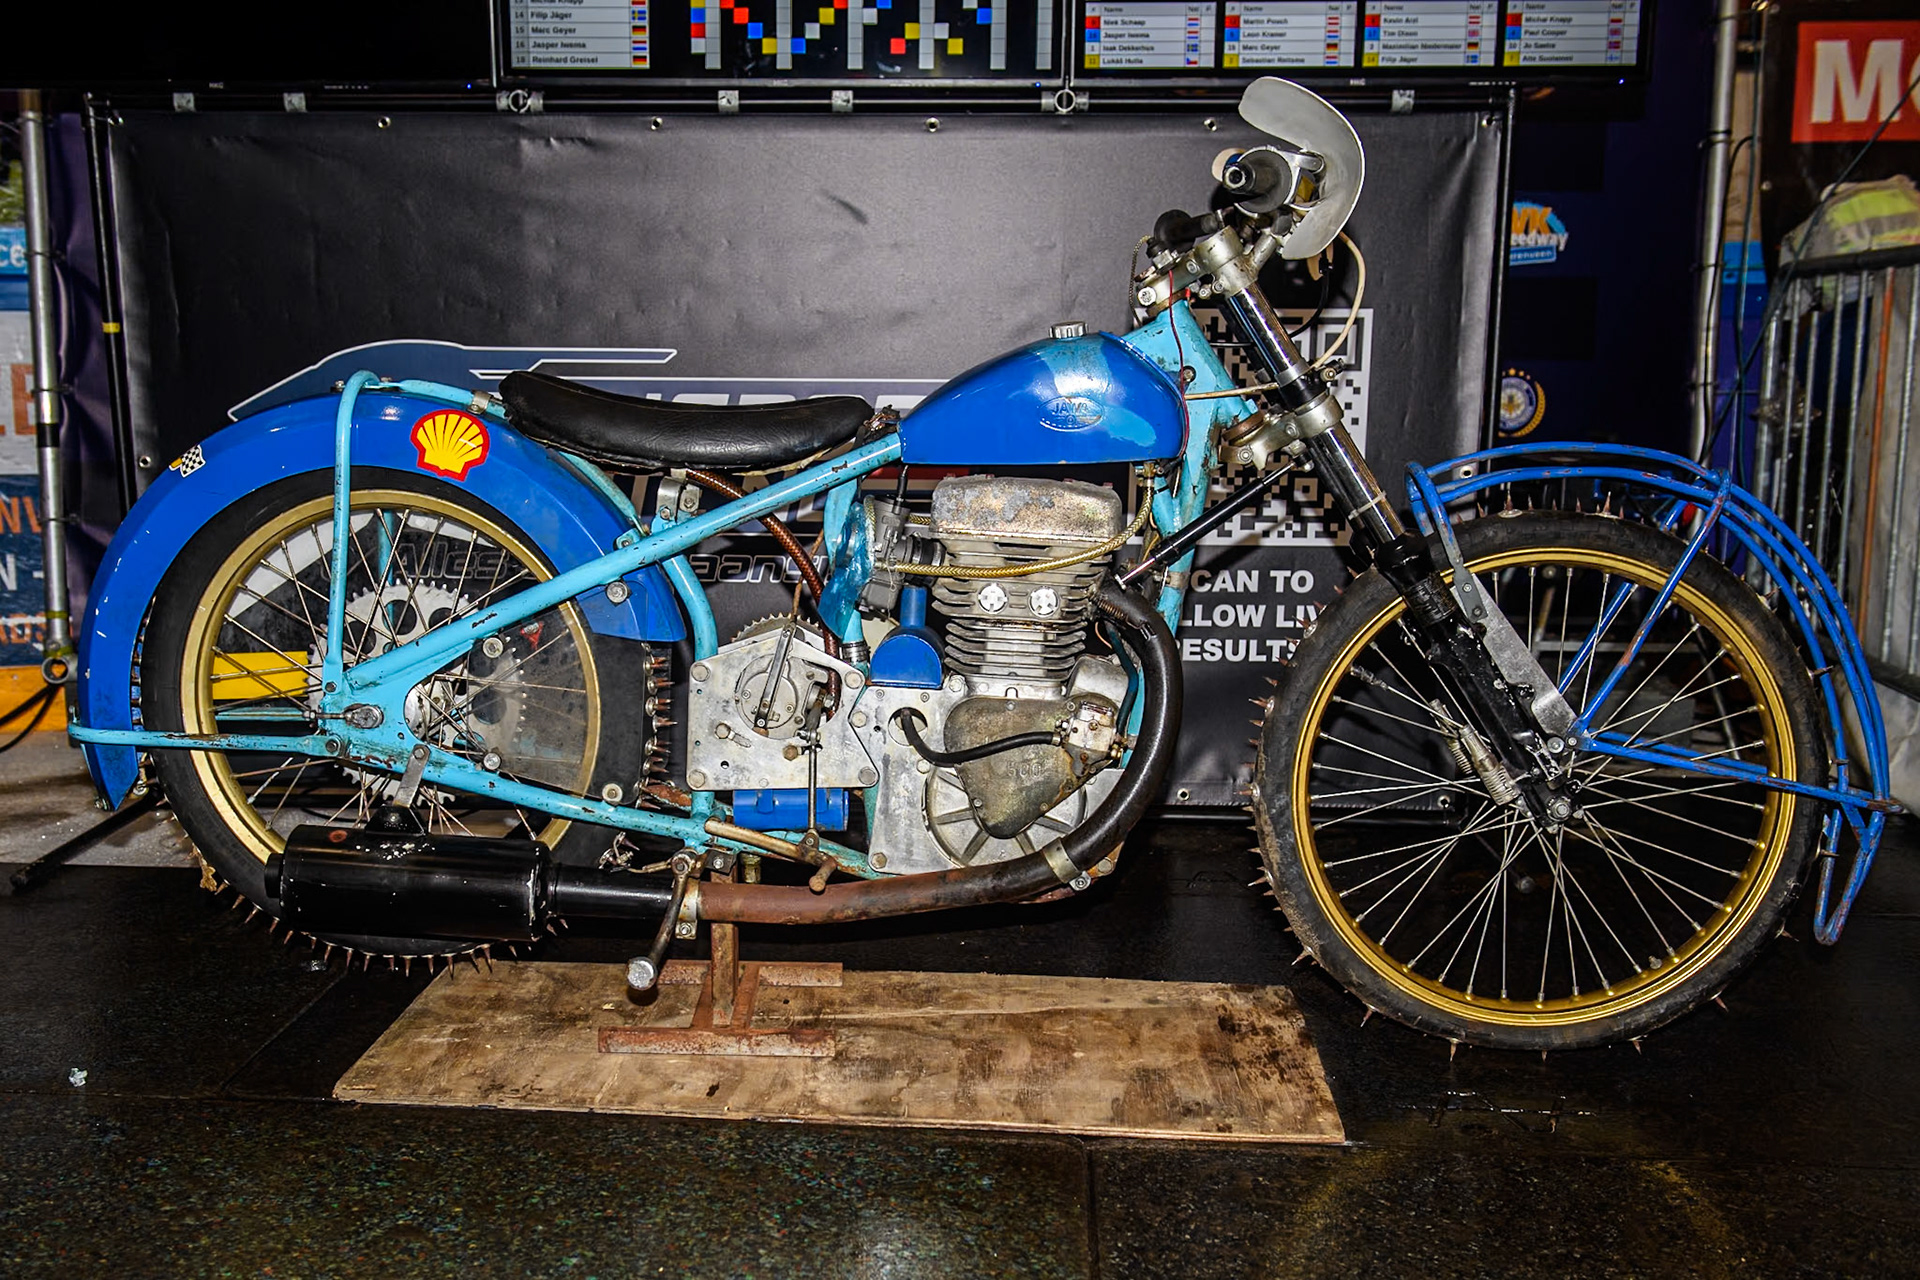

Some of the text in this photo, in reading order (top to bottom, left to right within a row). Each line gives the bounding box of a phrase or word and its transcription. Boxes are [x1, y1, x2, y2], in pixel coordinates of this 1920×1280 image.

[531, 10, 548, 20] Filip
[531, 26, 550, 34] Marc
[552, 26, 576, 36] Geyer
[532, 41, 560, 50] Jasper
[1811, 39, 1920, 123] M
[1270, 569, 1315, 594] TO
